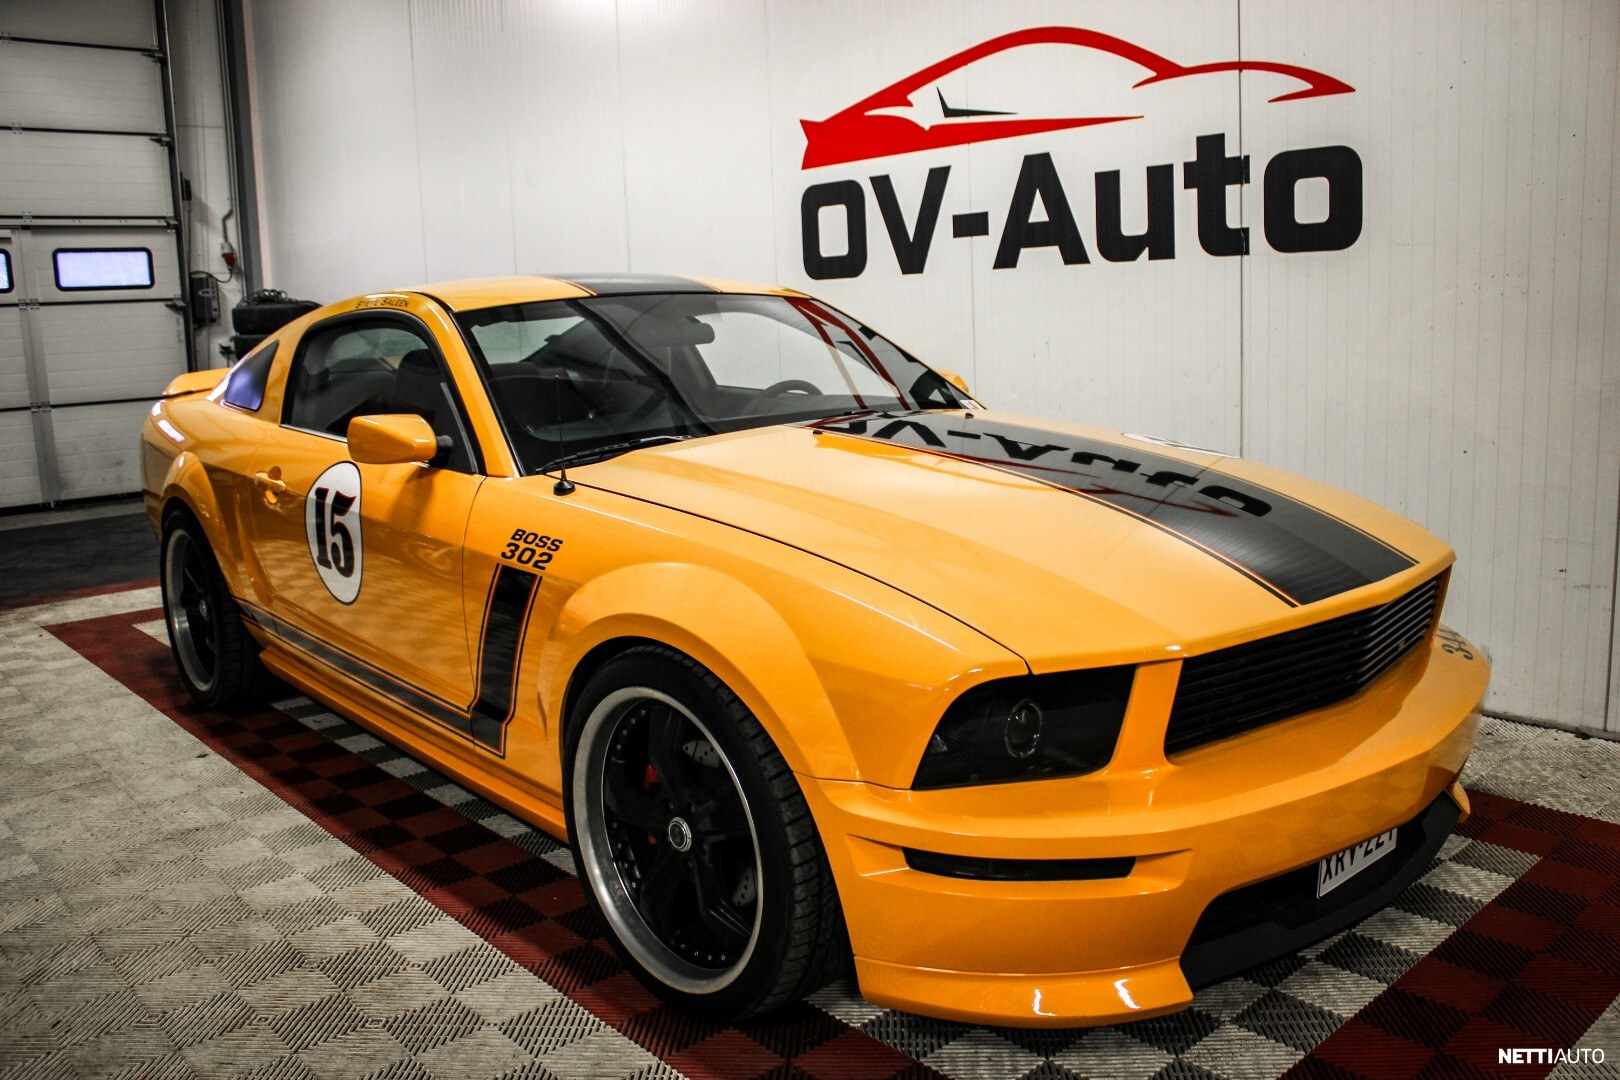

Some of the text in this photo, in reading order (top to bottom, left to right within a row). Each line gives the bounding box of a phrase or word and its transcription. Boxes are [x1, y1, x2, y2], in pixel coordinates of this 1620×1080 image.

[801, 132, 1363, 280] OV-Auto
[315, 486, 356, 578] 15
[500, 541, 554, 571] 302
[510, 528, 564, 552] BOSS
